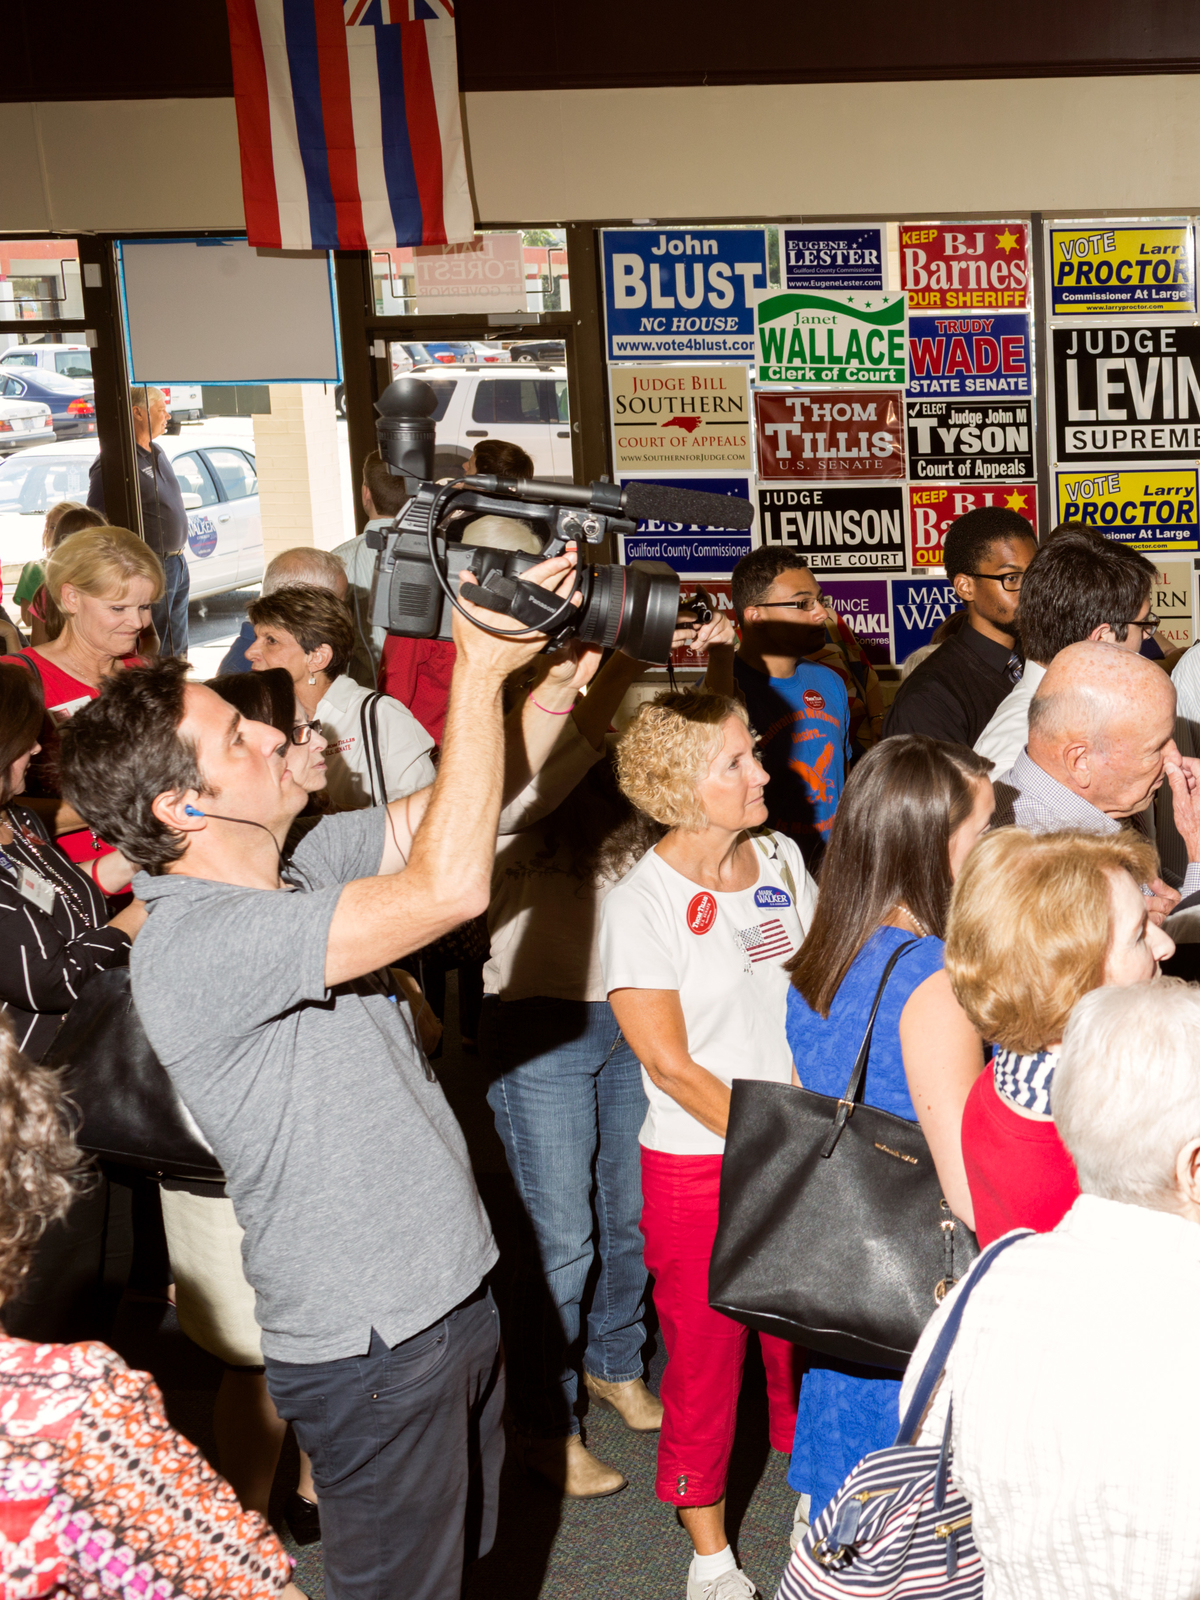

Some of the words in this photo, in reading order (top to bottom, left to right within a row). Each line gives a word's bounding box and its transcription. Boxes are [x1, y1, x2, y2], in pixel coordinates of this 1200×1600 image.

[651, 234, 719, 256] John
[788, 240, 848, 251] EUGENE
[902, 229, 938, 246] KEEP
[942, 232, 985, 256] BJ
[1059, 231, 1116, 261] VOTE
[788, 249, 880, 266] LESTER
[1139, 243, 1186, 257] Larry
[793, 267, 816, 275] Guilford
[816, 267, 836, 276] County
[836, 266, 875, 274] Commissioner
[903, 248, 1027, 290] Barnes
[1056, 259, 1190, 285] PROCTOR
[612, 253, 763, 309] BLUST
[788, 280, 882, 289] www.EugeneLester.com
[908, 291, 941, 306] OUR
[945, 291, 1026, 307] SHERIFF
[1062, 292, 1132, 301] Commissioner
[1134, 289, 1149, 299] At
[1152, 289, 1187, 300] Large
[639, 317, 666, 332] NC
[670, 317, 739, 332] HOUSE
[794, 311, 838, 327] Janet
[935, 318, 995, 334] TRUDY
[758, 327, 905, 367] WALLACE
[1066, 328, 1177, 355] JUDGE
[909, 335, 1027, 376] WADE
[768, 366, 816, 380] Clerk
[821, 367, 840, 380] of
[845, 367, 897, 381] Court
[632, 376, 686, 395] JUDGE
[692, 375, 727, 391] BILL
[910, 379, 960, 393] STATE
[964, 377, 1028, 392] SENATE
[616, 394, 744, 414] SOUTHERN
[785, 397, 878, 422] THOM
[922, 403, 947, 415] ELECT
[948, 409, 983, 428] Judge
[985, 408, 1014, 424] John
[1016, 408, 1027, 424] M
[618, 436, 666, 448] COURT
[670, 436, 688, 448] OF
[692, 435, 746, 448] APPEALS
[764, 422, 894, 459] TILLIS
[908, 417, 1029, 454] TYSON
[779, 460, 810, 470] U.S.
[818, 459, 884, 470] SENATE
[918, 459, 955, 477] Court
[958, 459, 971, 476] of
[975, 458, 1026, 479] Appeals
[1065, 473, 1121, 501] VOTE
[1143, 485, 1195, 498] Larry
[764, 491, 824, 506] JUDGE
[912, 490, 948, 505] KEEP
[1063, 500, 1195, 525] PROCTOR
[764, 509, 902, 546] LEVINSON
[1139, 529, 1154, 539] At
[1156, 528, 1190, 540] Large
[627, 543, 661, 558] Guilford
[661, 543, 691, 560] County
[692, 542, 750, 557] Commissioner
[848, 553, 899, 567] COURT
[790, 728, 828, 744] Desire...
[756, 894, 788, 904] WALKER
